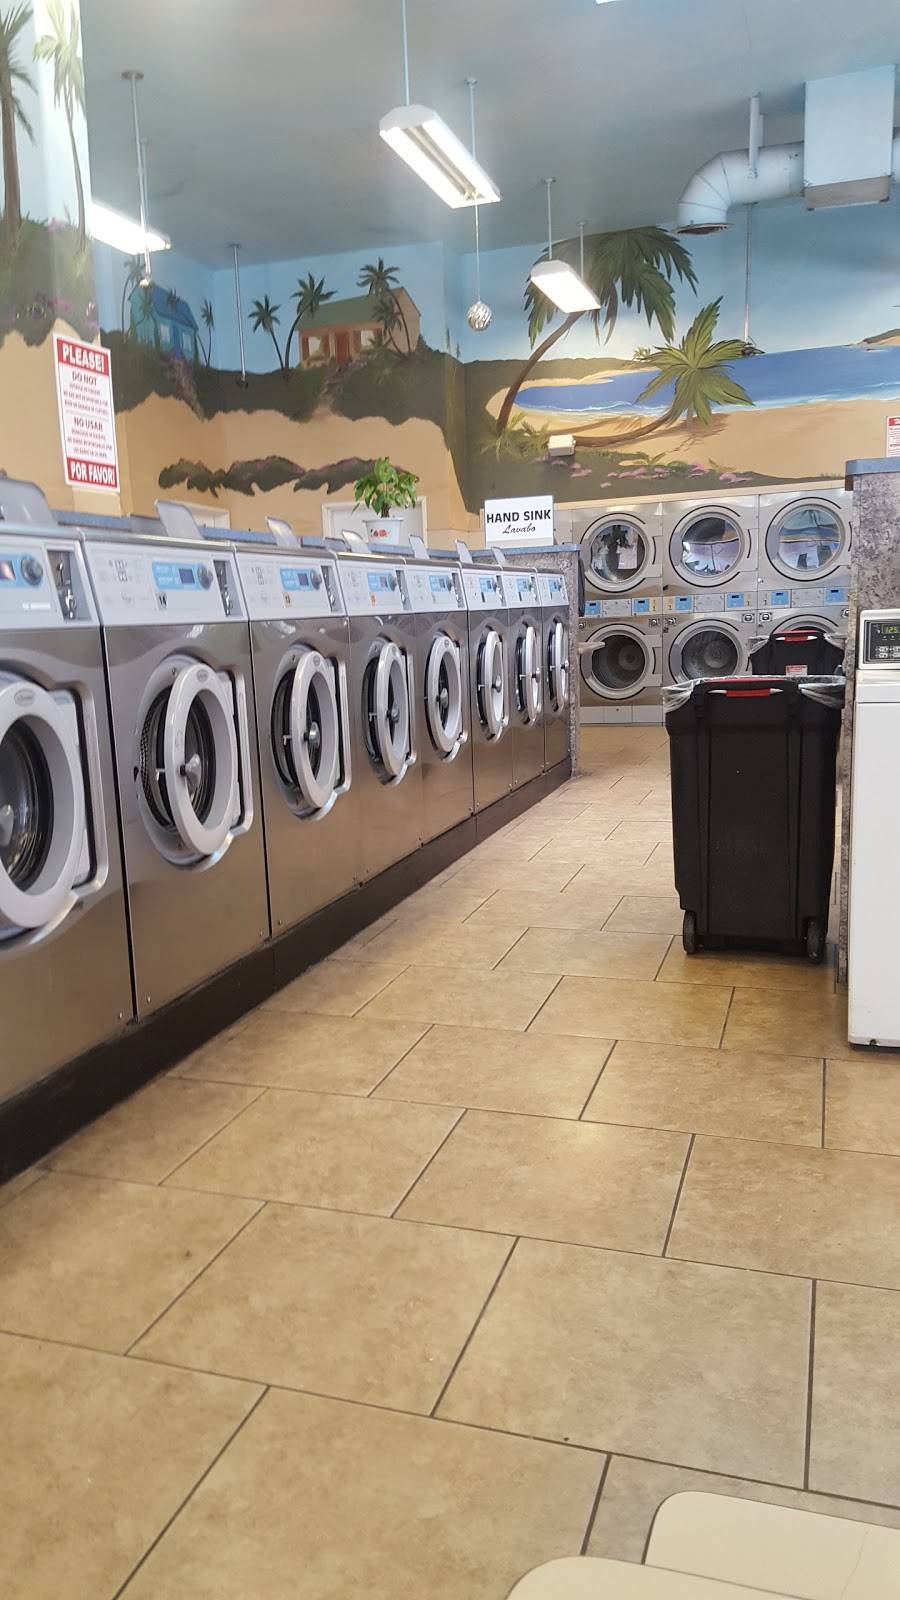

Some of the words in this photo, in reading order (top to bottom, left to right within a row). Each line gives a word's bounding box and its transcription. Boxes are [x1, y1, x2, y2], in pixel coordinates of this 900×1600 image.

[62, 342, 105, 374] PLEASE!
[72, 371, 83, 381] DO
[83, 374, 98, 386] NOT
[74, 416, 84, 428] NO
[85, 418, 103, 432] USAR
[70, 461, 87, 481] POR
[88, 464, 116, 486] FAVOR!
[486, 512, 520, 524] HAND
[523, 509, 551, 521] SINK
[502, 522, 536, 534] Lavabo
